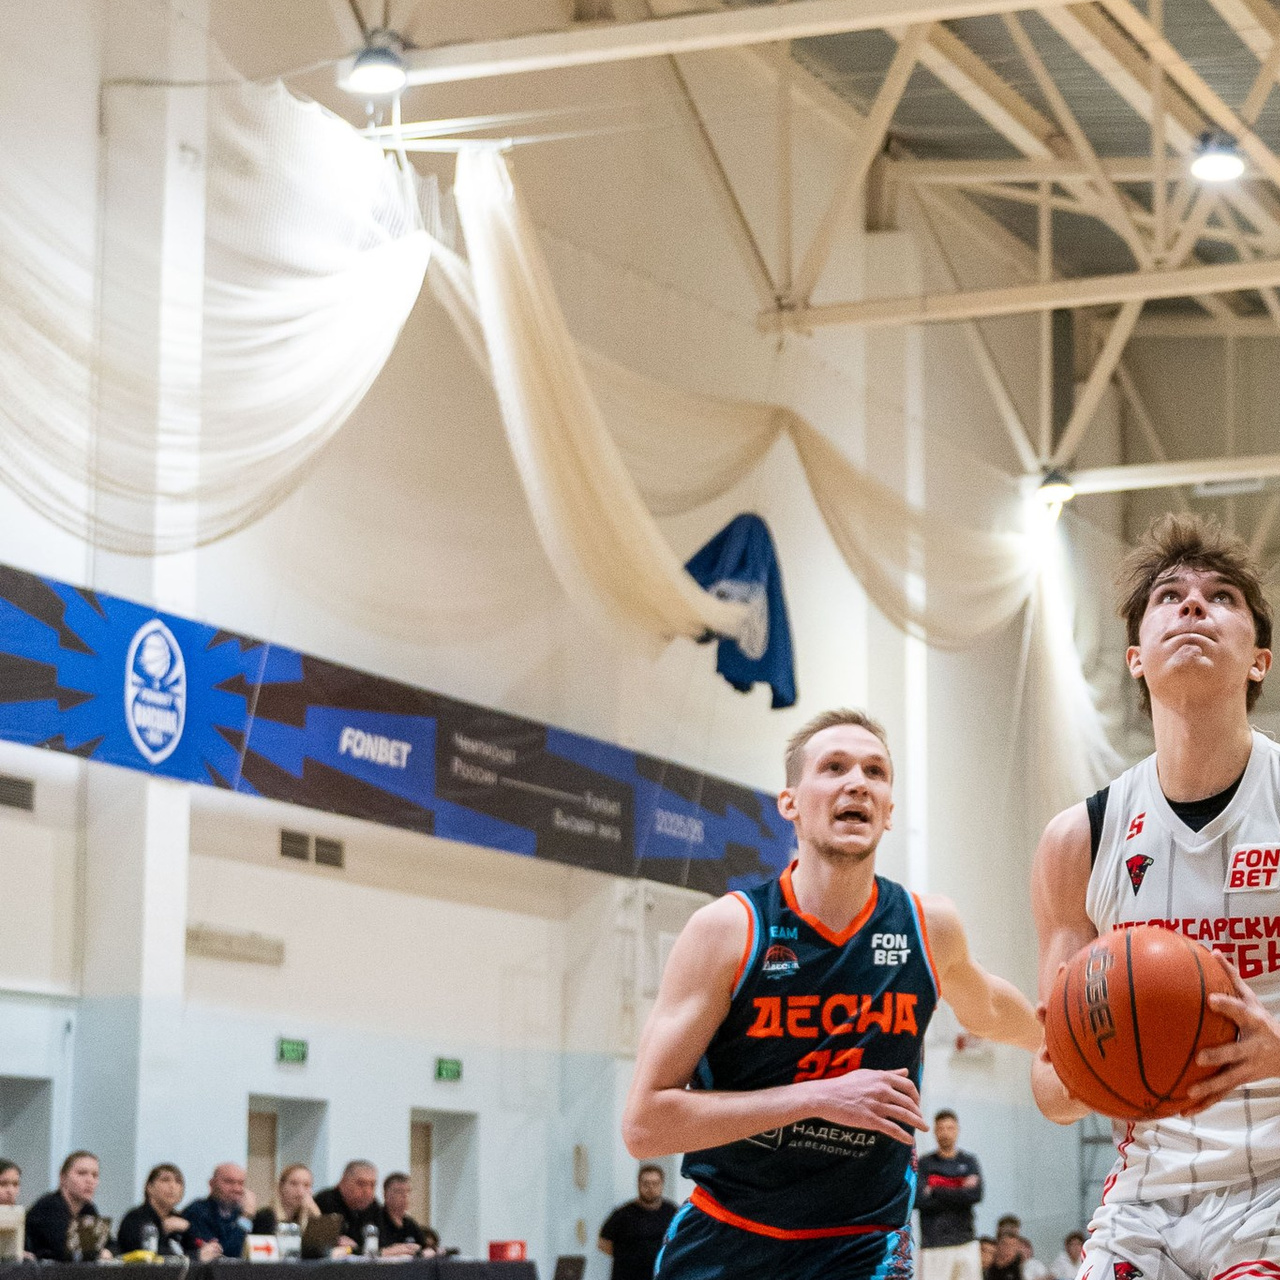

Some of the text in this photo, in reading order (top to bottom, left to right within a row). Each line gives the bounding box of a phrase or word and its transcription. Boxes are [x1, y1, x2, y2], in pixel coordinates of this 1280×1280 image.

[339, 726, 412, 769] FONBET
[1232, 848, 1280, 869] FON
[1229, 868, 1278, 888] BET
[769, 925, 798, 940] EAM
[871, 933, 908, 949] FON
[873, 949, 911, 966] BET
[746, 991, 918, 1039] ДЕСНА
[792, 1122, 877, 1146] НАДЕЖДА
